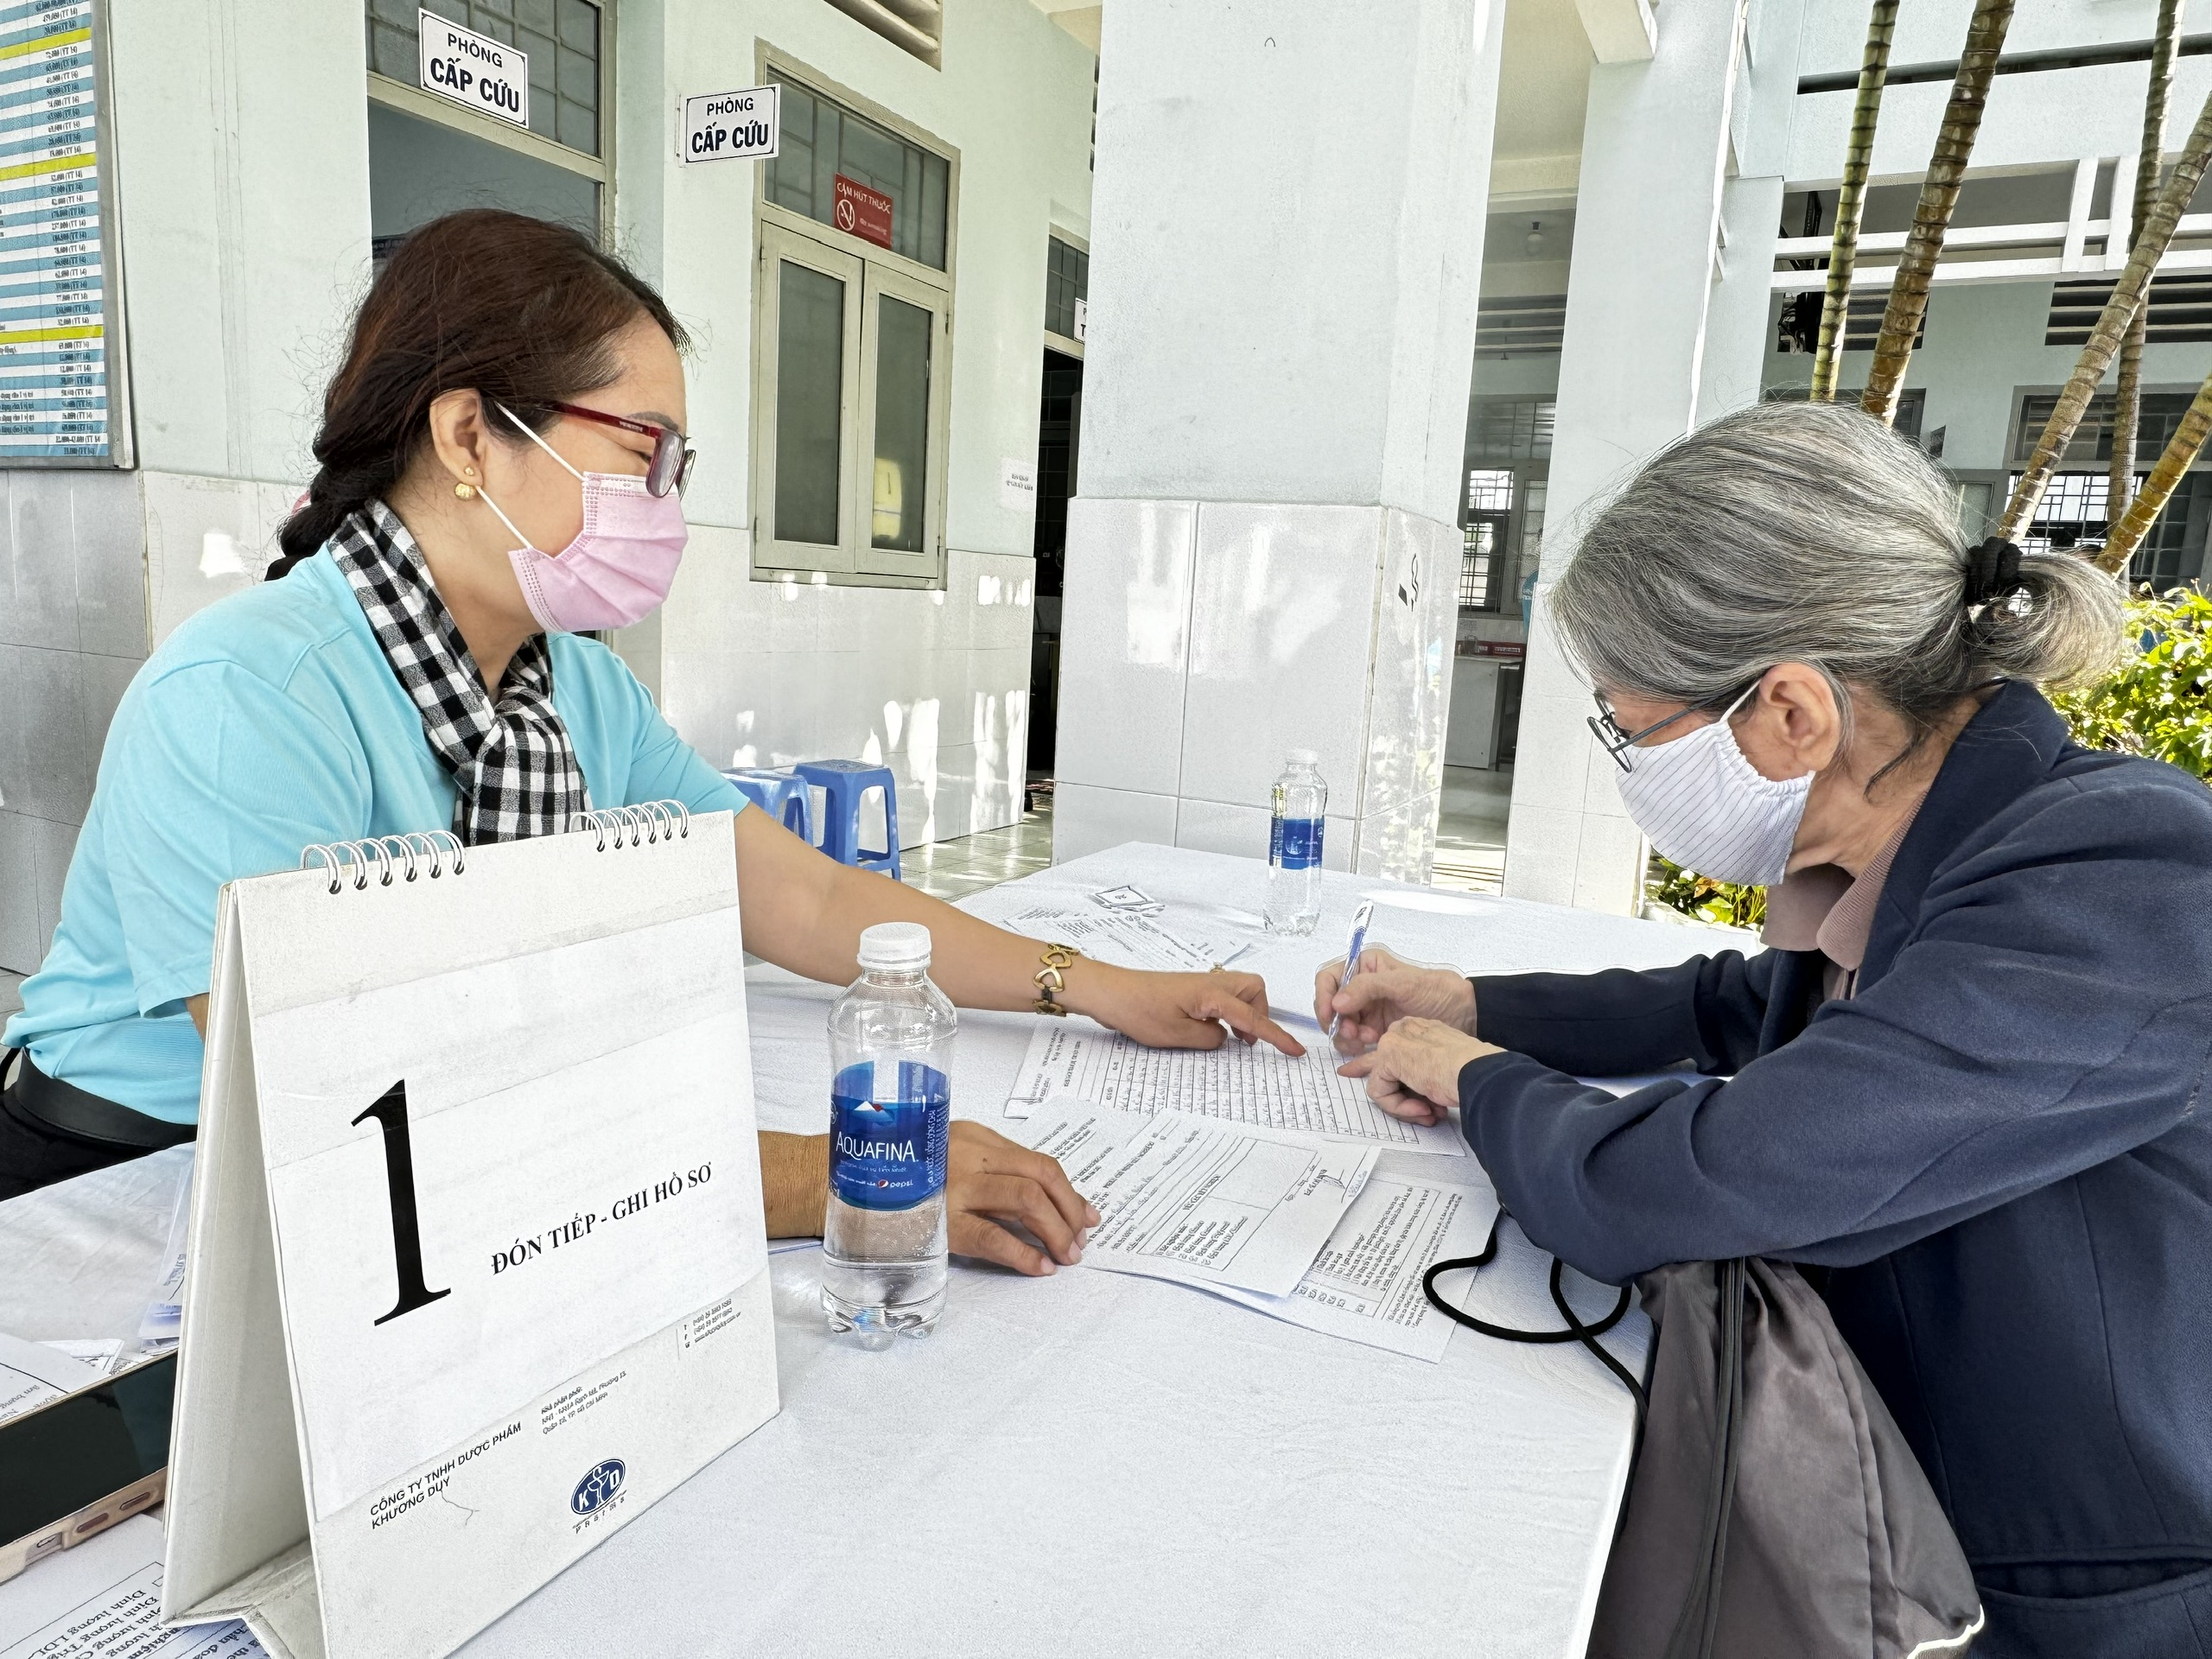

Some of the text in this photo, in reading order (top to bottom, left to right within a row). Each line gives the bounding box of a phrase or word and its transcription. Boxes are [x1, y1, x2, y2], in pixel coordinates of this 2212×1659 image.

[448, 32, 503, 68] PHÒNG
[429, 57, 519, 113] CẤP CỨU
[707, 97, 753, 116] PHÒNG
[691, 119, 769, 154] CẤP CỨU
[836, 1131, 917, 1163] AQUAFINA
[351, 1077, 452, 1327] 1
[491, 1235, 543, 1275] ĐÓN
[548, 1212, 596, 1249] TIẾP
[612, 1188, 649, 1220] GHI
[654, 1171, 683, 1204] HỒ
[688, 1161, 712, 1189] SƠ
[370, 1488, 406, 1516] CÔNG
[408, 1478, 423, 1494] TY
[424, 1459, 456, 1484] TNHH
[458, 1439, 491, 1465] DƯỢC
[372, 1476, 450, 1529] KHƯƠNG DUY
[110, 1589, 147, 1611] Định
[67, 1610, 112, 1635] lượng
